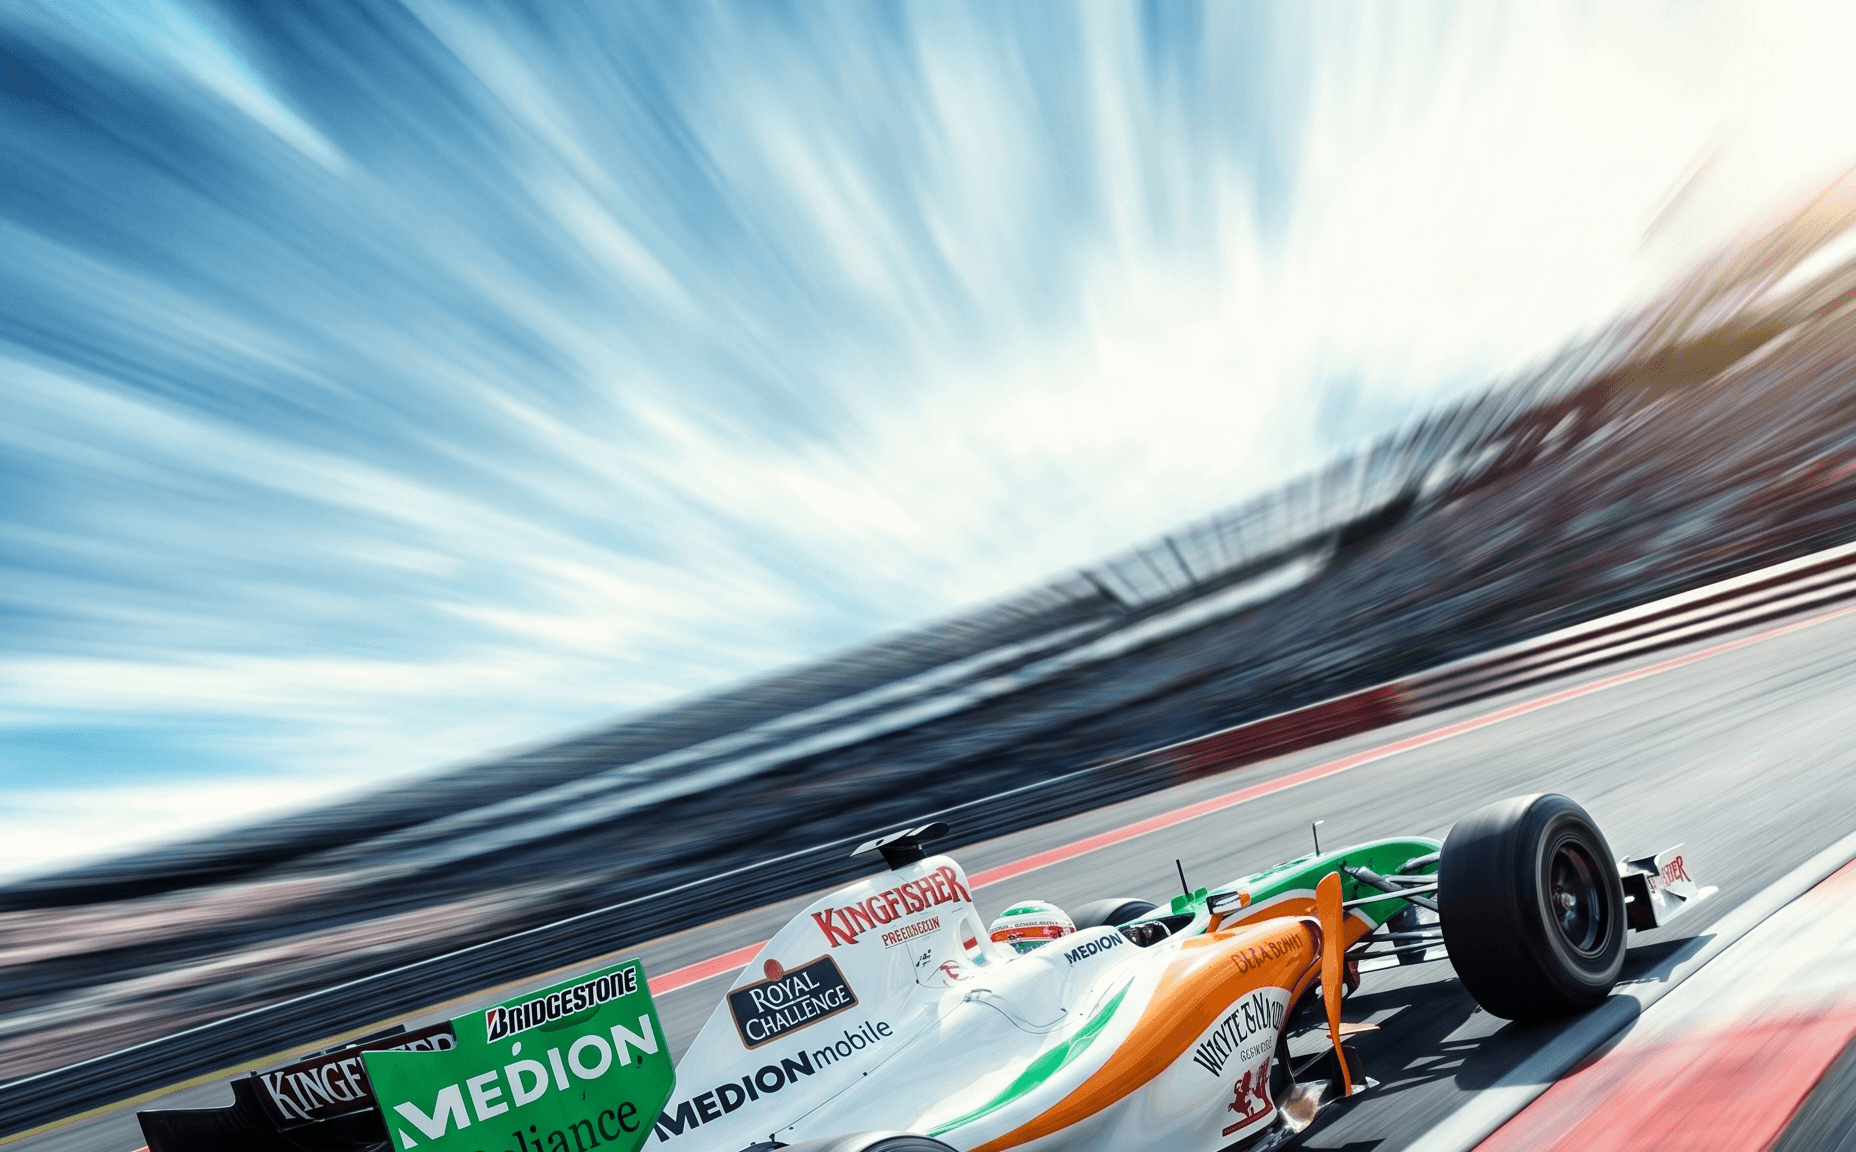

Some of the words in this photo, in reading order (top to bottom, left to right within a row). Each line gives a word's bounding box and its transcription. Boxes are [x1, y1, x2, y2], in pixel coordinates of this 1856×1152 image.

[811, 865, 972, 948] KINGFISHER
[1063, 932, 1123, 965] MEDION
[486, 966, 638, 1044] BRIDGESTONE
[745, 985, 850, 1041] CHALLENGE
[749, 972, 821, 1014] ROYAL
